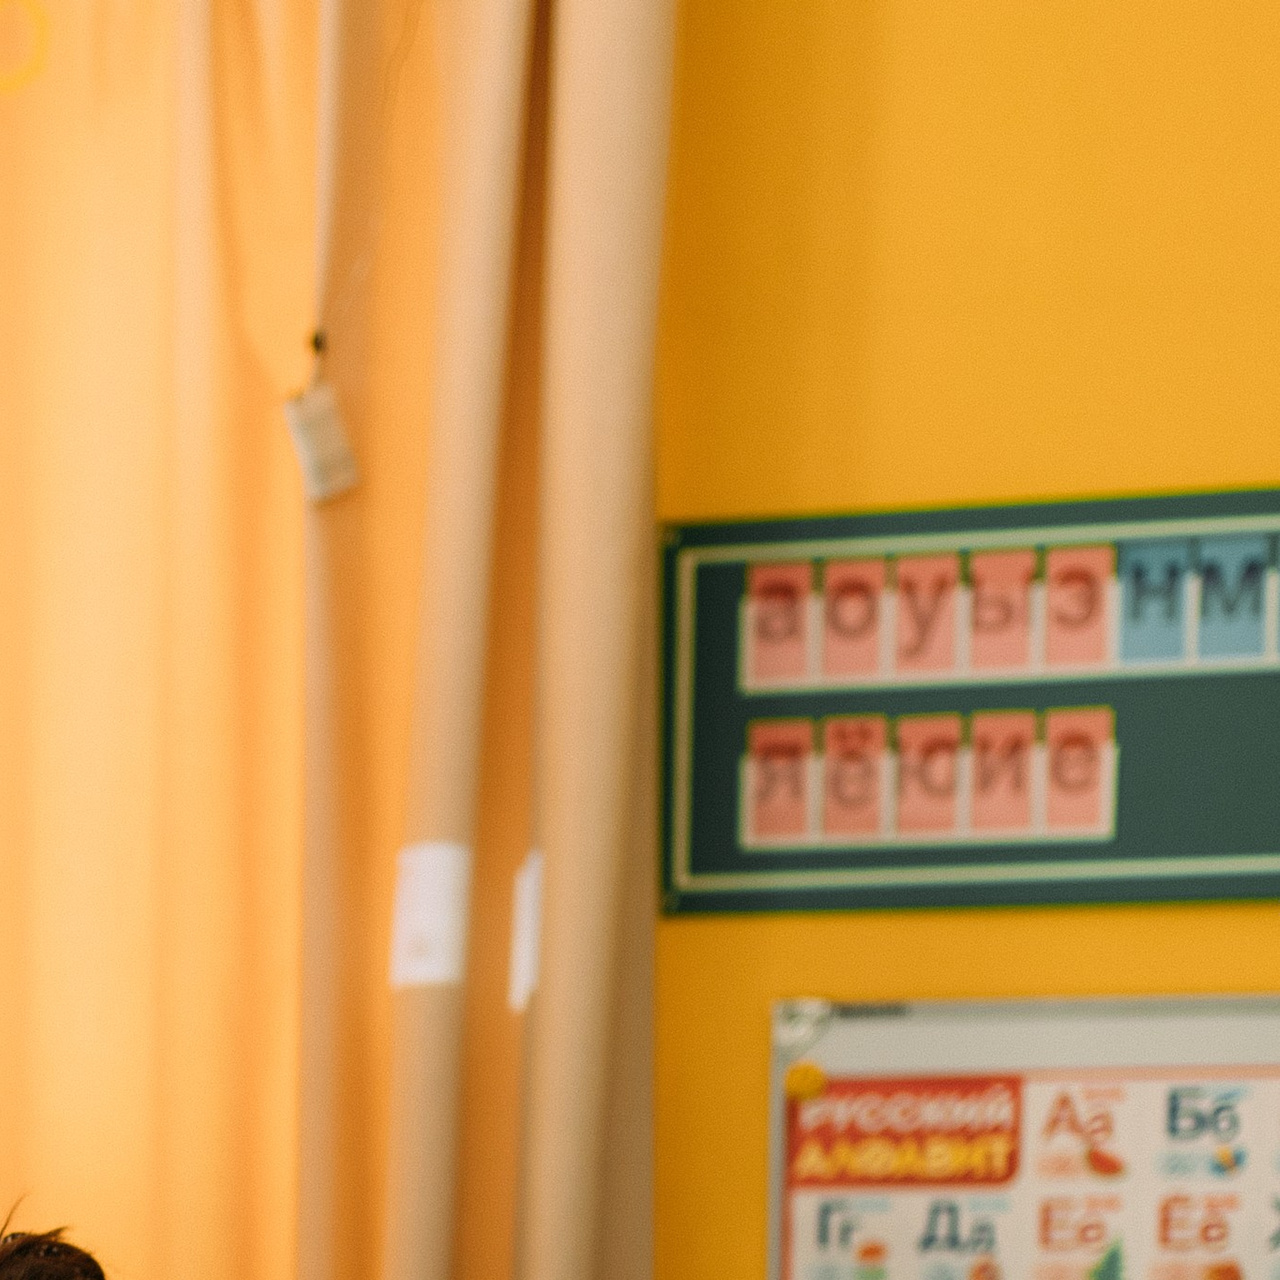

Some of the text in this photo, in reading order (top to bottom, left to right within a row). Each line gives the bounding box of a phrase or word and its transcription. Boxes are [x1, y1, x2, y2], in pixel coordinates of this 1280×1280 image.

[1043, 1090, 1115, 1141] Аа
[1166, 1086, 1241, 1142] Бб
[816, 1202, 858, 1251] Гг
[918, 1202, 998, 1253] Дд
